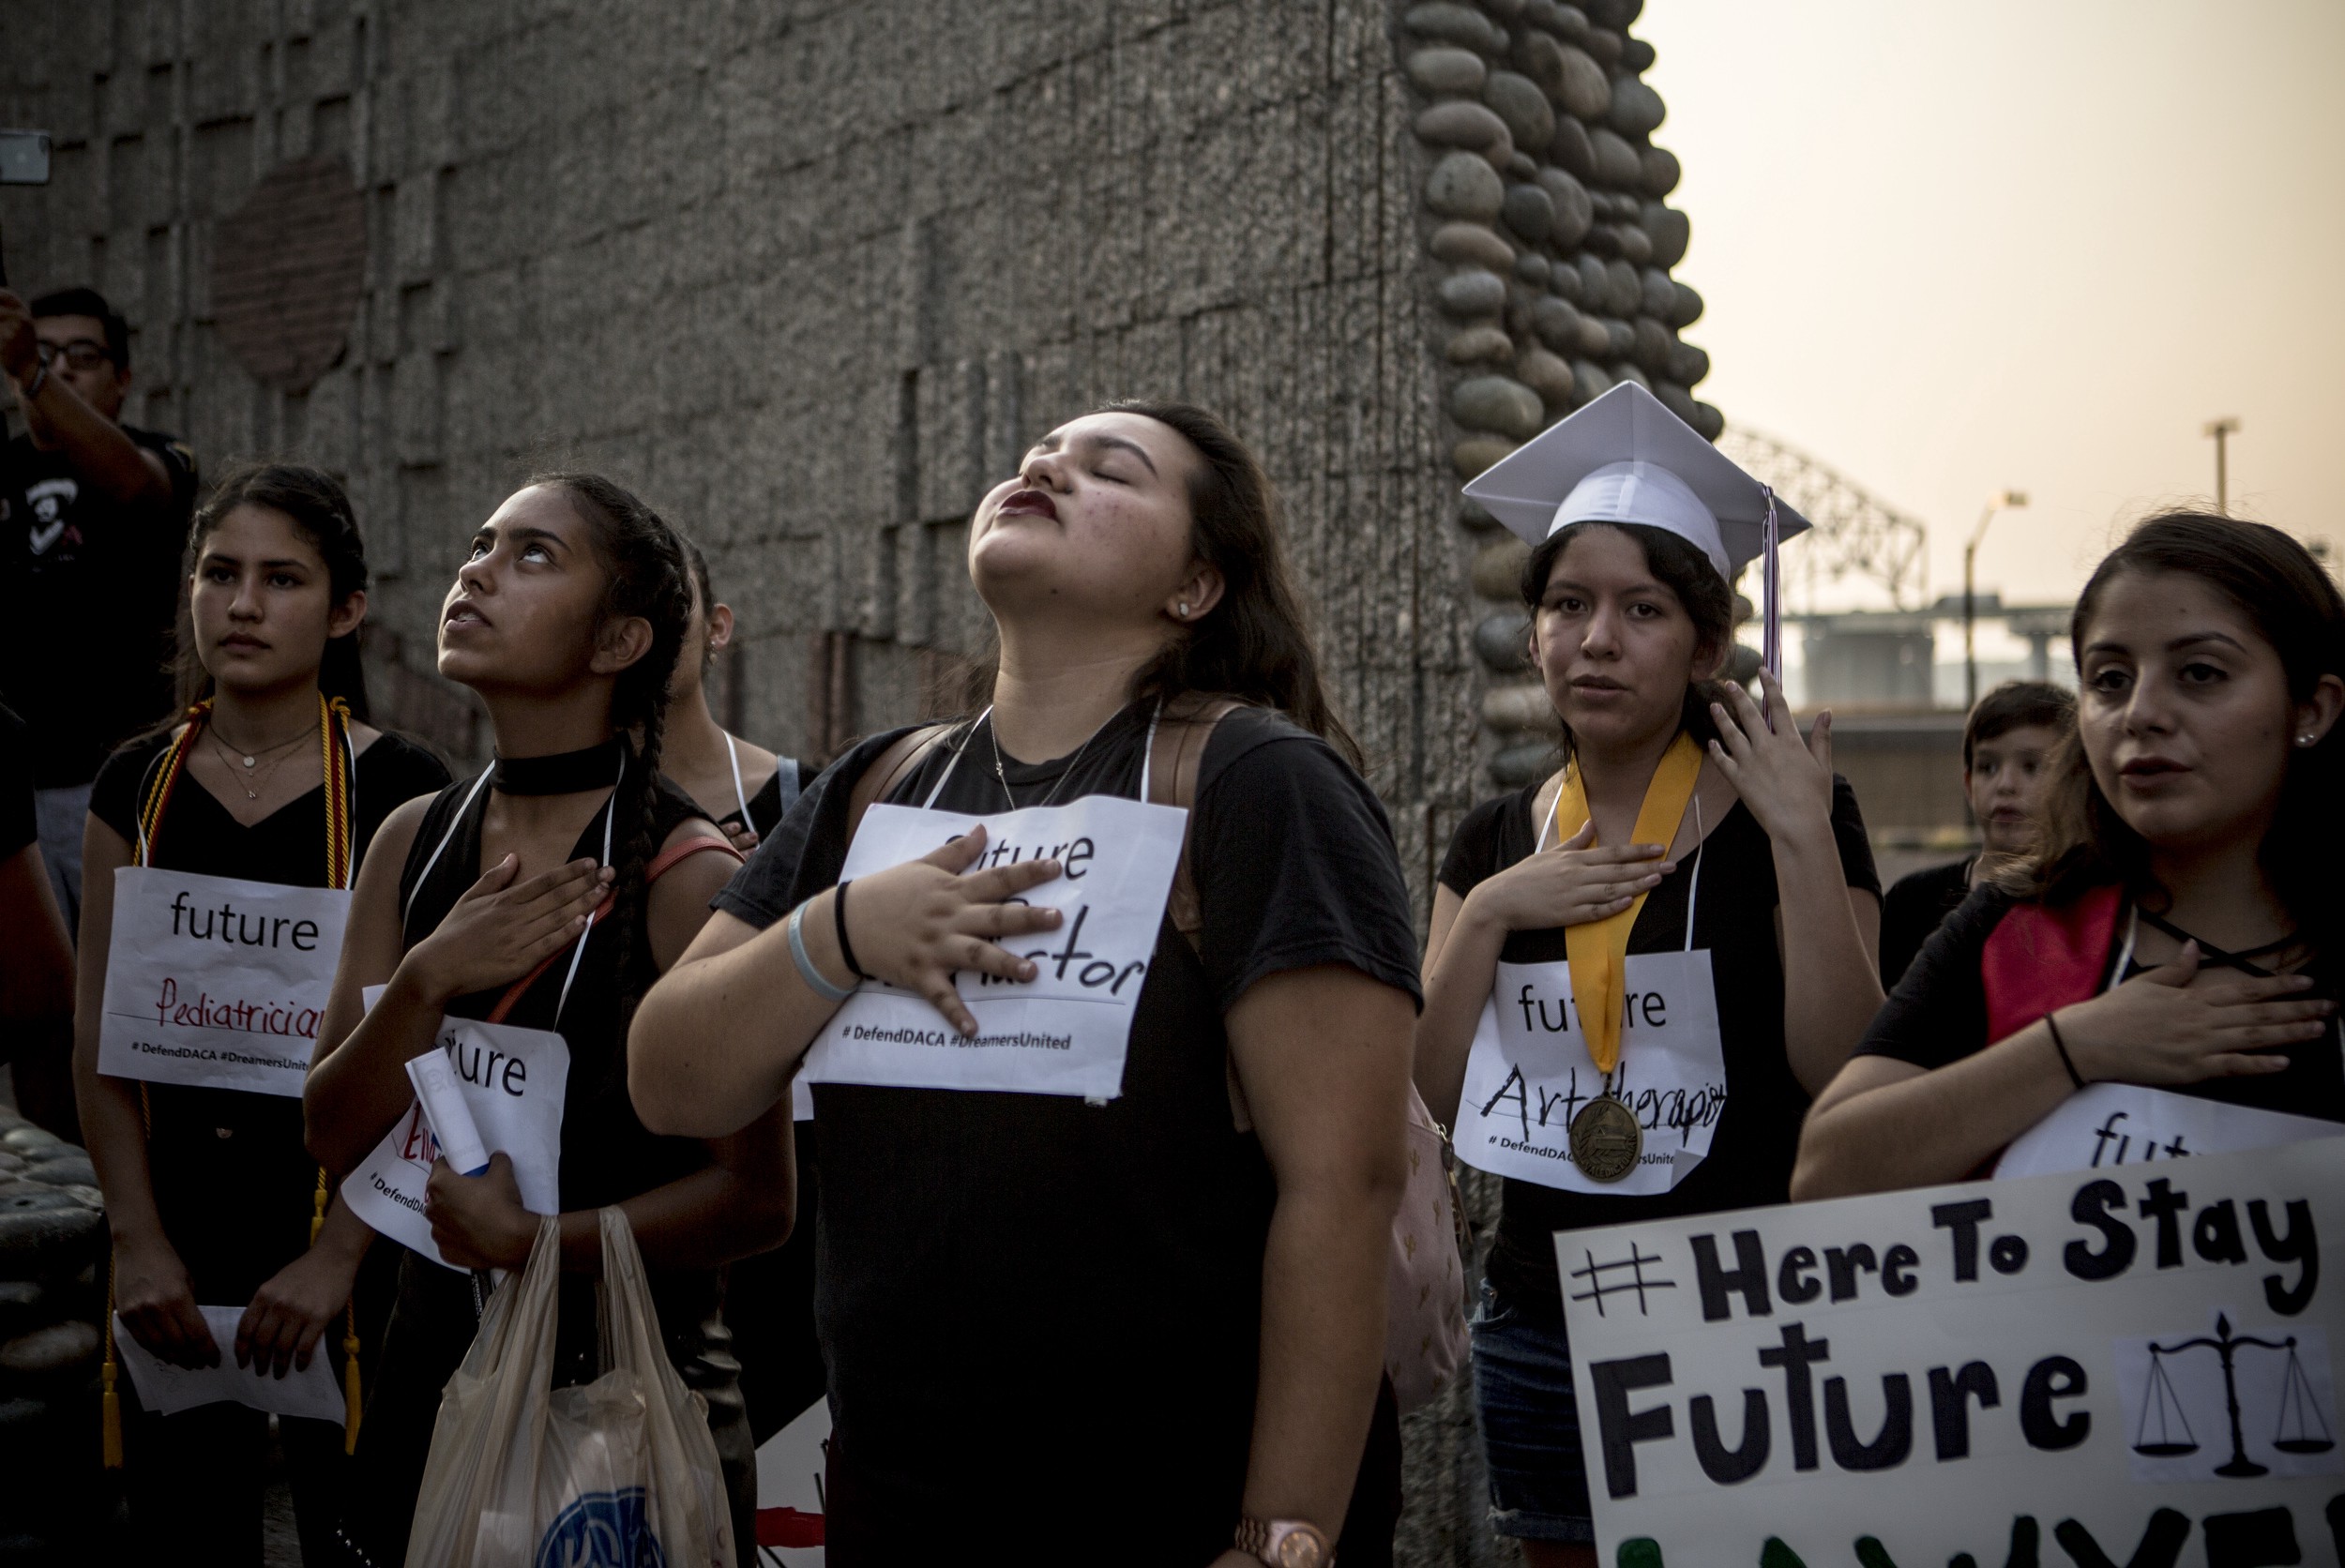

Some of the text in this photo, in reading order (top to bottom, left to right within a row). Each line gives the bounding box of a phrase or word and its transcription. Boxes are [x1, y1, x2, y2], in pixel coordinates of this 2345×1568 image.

[171, 892, 319, 952] future
[854, 1024, 946, 1048] DefendDACA
[1518, 985, 1667, 1033] fure
[142, 1042, 218, 1062] DefendDACA
[219, 1051, 310, 1072] #DreamersUnit
[1480, 1063, 1589, 1142] Art
[1931, 1198, 2030, 1283] To
[2064, 1178, 2320, 1316] Stay
[1589, 1321, 2092, 1500] Future
